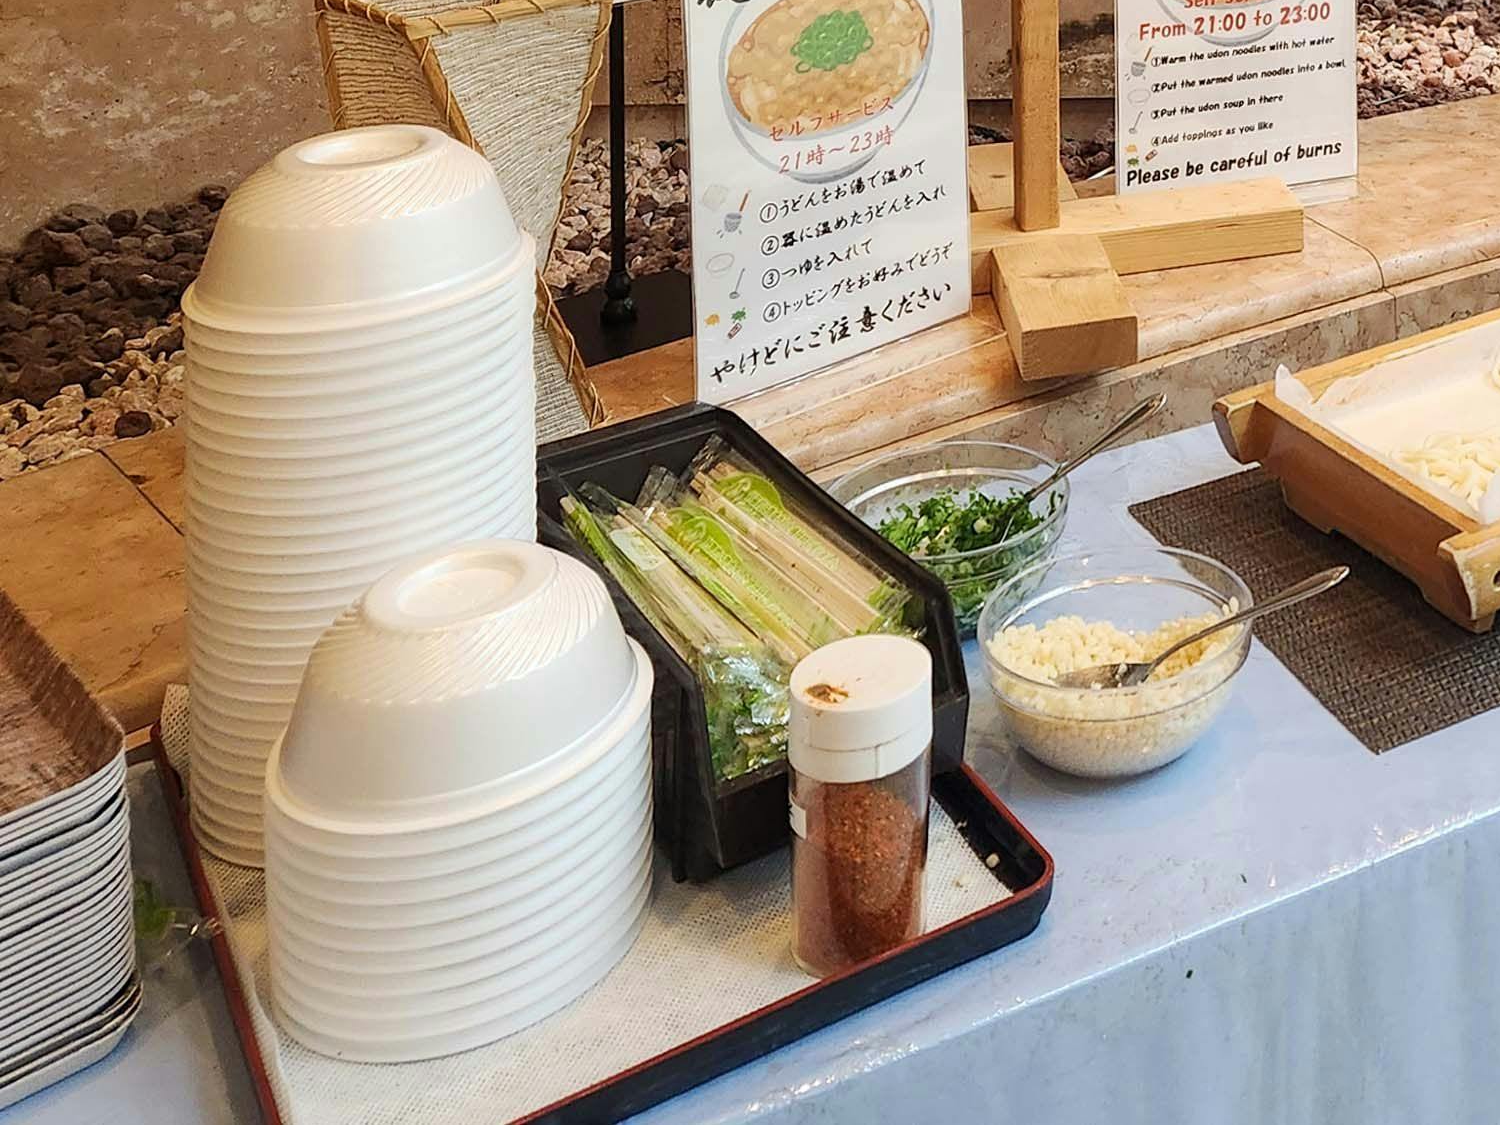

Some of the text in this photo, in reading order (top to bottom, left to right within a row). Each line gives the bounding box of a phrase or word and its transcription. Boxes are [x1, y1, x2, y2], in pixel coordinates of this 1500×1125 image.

[1139, 2, 1331, 41] From 21:00 to 23:00
[1190, 49, 1204, 61] the
[1207, 48, 1230, 59] udon
[1232, 44, 1266, 57] noodles
[1269, 40, 1289, 52] with
[1292, 38, 1306, 49] hot
[1309, 35, 1335, 47] water
[1181, 76, 1196, 88] the
[1199, 72, 1234, 86] warmed
[1236, 69, 1259, 82] udon
[1261, 65, 1294, 79] noodles
[1298, 62, 1316, 73] into
[1325, 58, 1346, 70] bowl
[769, 96, 895, 143] セルフサービス
[1180, 104, 1196, 116] the
[1198, 101, 1220, 113] udon
[1223, 98, 1245, 110] soup
[1247, 96, 1256, 106] in
[1258, 93, 1284, 105] there
[1226, 127, 1236, 135] as
[1239, 124, 1255, 135] you
[1258, 121, 1274, 131] like
[1126, 139, 1343, 187] Please be careful of burns
[710, 283, 952, 384] やけどにご注意ください
